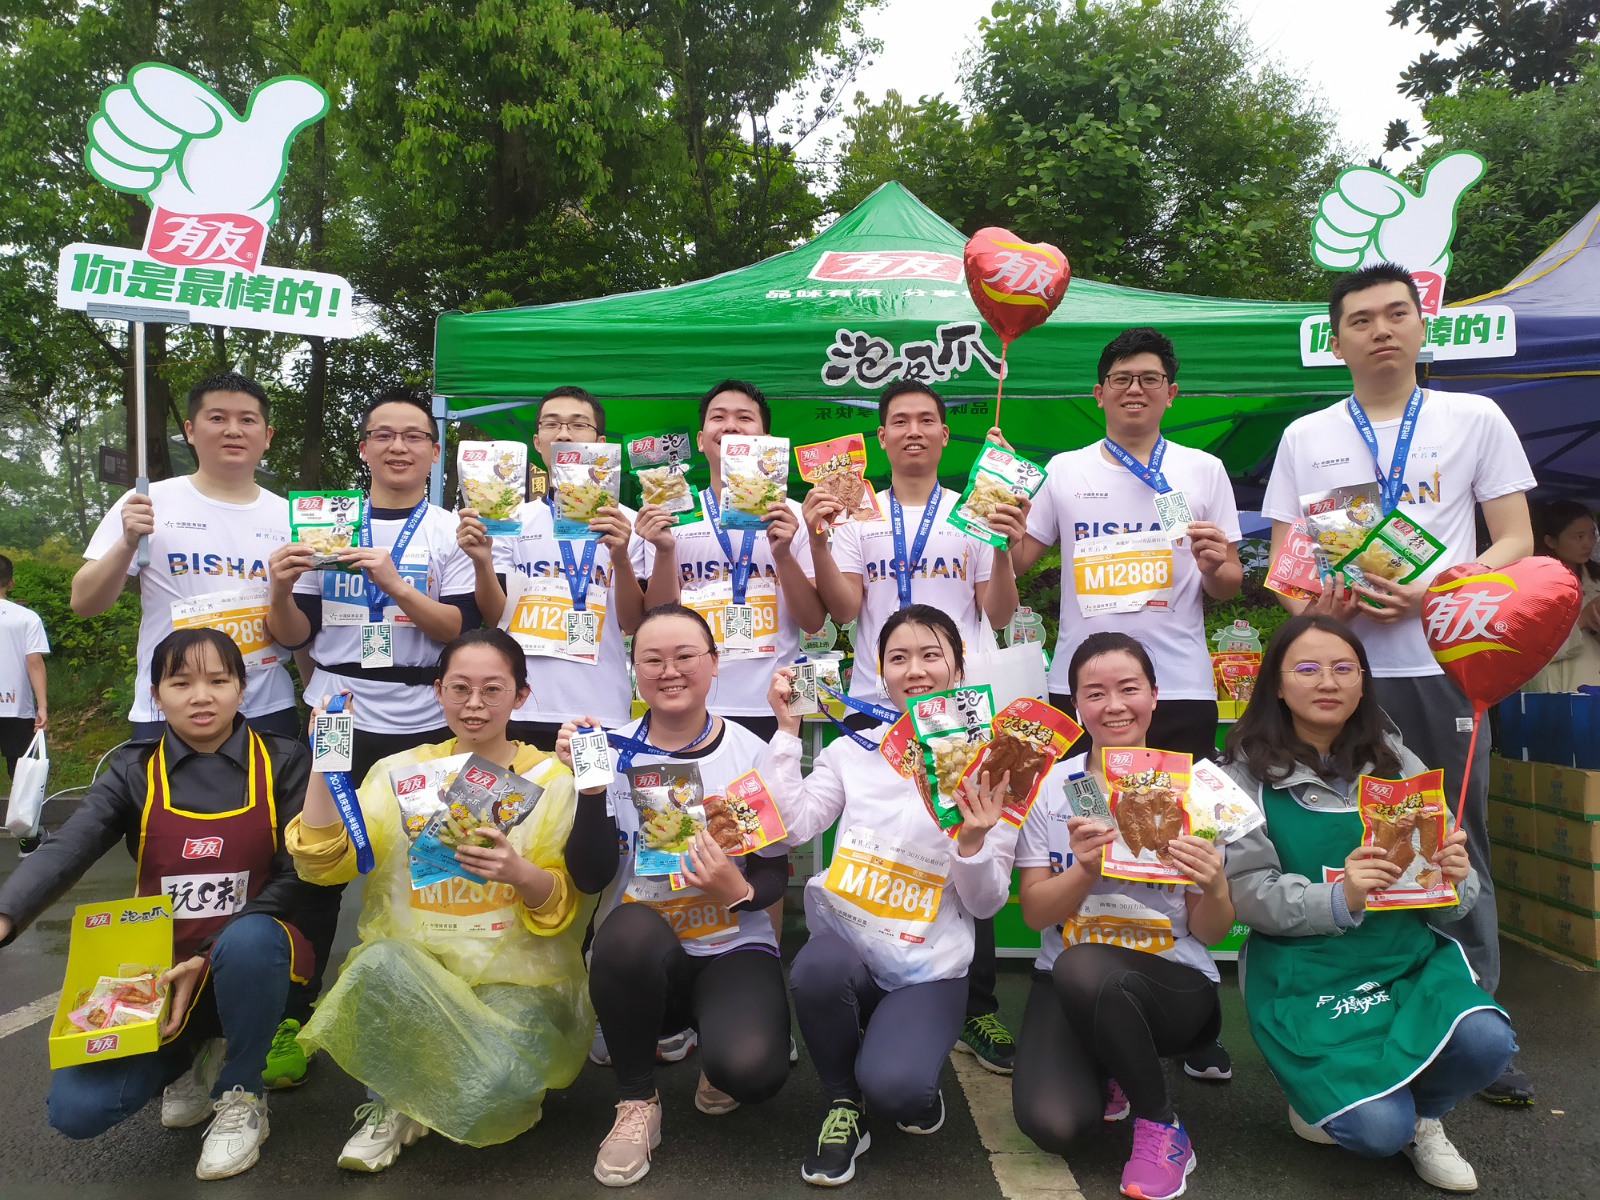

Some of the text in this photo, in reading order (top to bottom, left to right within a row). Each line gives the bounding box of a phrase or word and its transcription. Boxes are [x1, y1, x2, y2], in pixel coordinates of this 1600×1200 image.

[151, 216, 254, 262] 有友
[829, 252, 956, 277] 有友
[983, 251, 1059, 300] 有友
[71, 253, 341, 318] 你是最棒的!
[766, 288, 883, 299] 品味有友
[1416, 278, 1437, 311] 友
[634, 440, 654, 451] 有友
[727, 446, 747, 455] 有友
[463, 451, 485, 461] 有友
[558, 452, 579, 463] 有友
[299, 498, 322, 509] 有友
[1312, 499, 1335, 514] 有友
[1074, 522, 1162, 541] BISHA
[167, 553, 268, 582] BISHA
[866, 556, 967, 583] BISHAN
[1084, 560, 1169, 591] M12888
[1426, 589, 1513, 644] 有友
[872, 707, 897, 722] 时代云著
[920, 702, 944, 716] 有友
[398, 777, 425, 794] 有友
[466, 769, 496, 790] 有友
[637, 774, 659, 787] 有友
[1368, 781, 1390, 796] 有友
[188, 840, 220, 856] 有友
[838, 863, 935, 918] M12884
[88, 914, 111, 926] 有友
[662, 904, 731, 933] 12881
[88, 1036, 117, 1052] 有友
